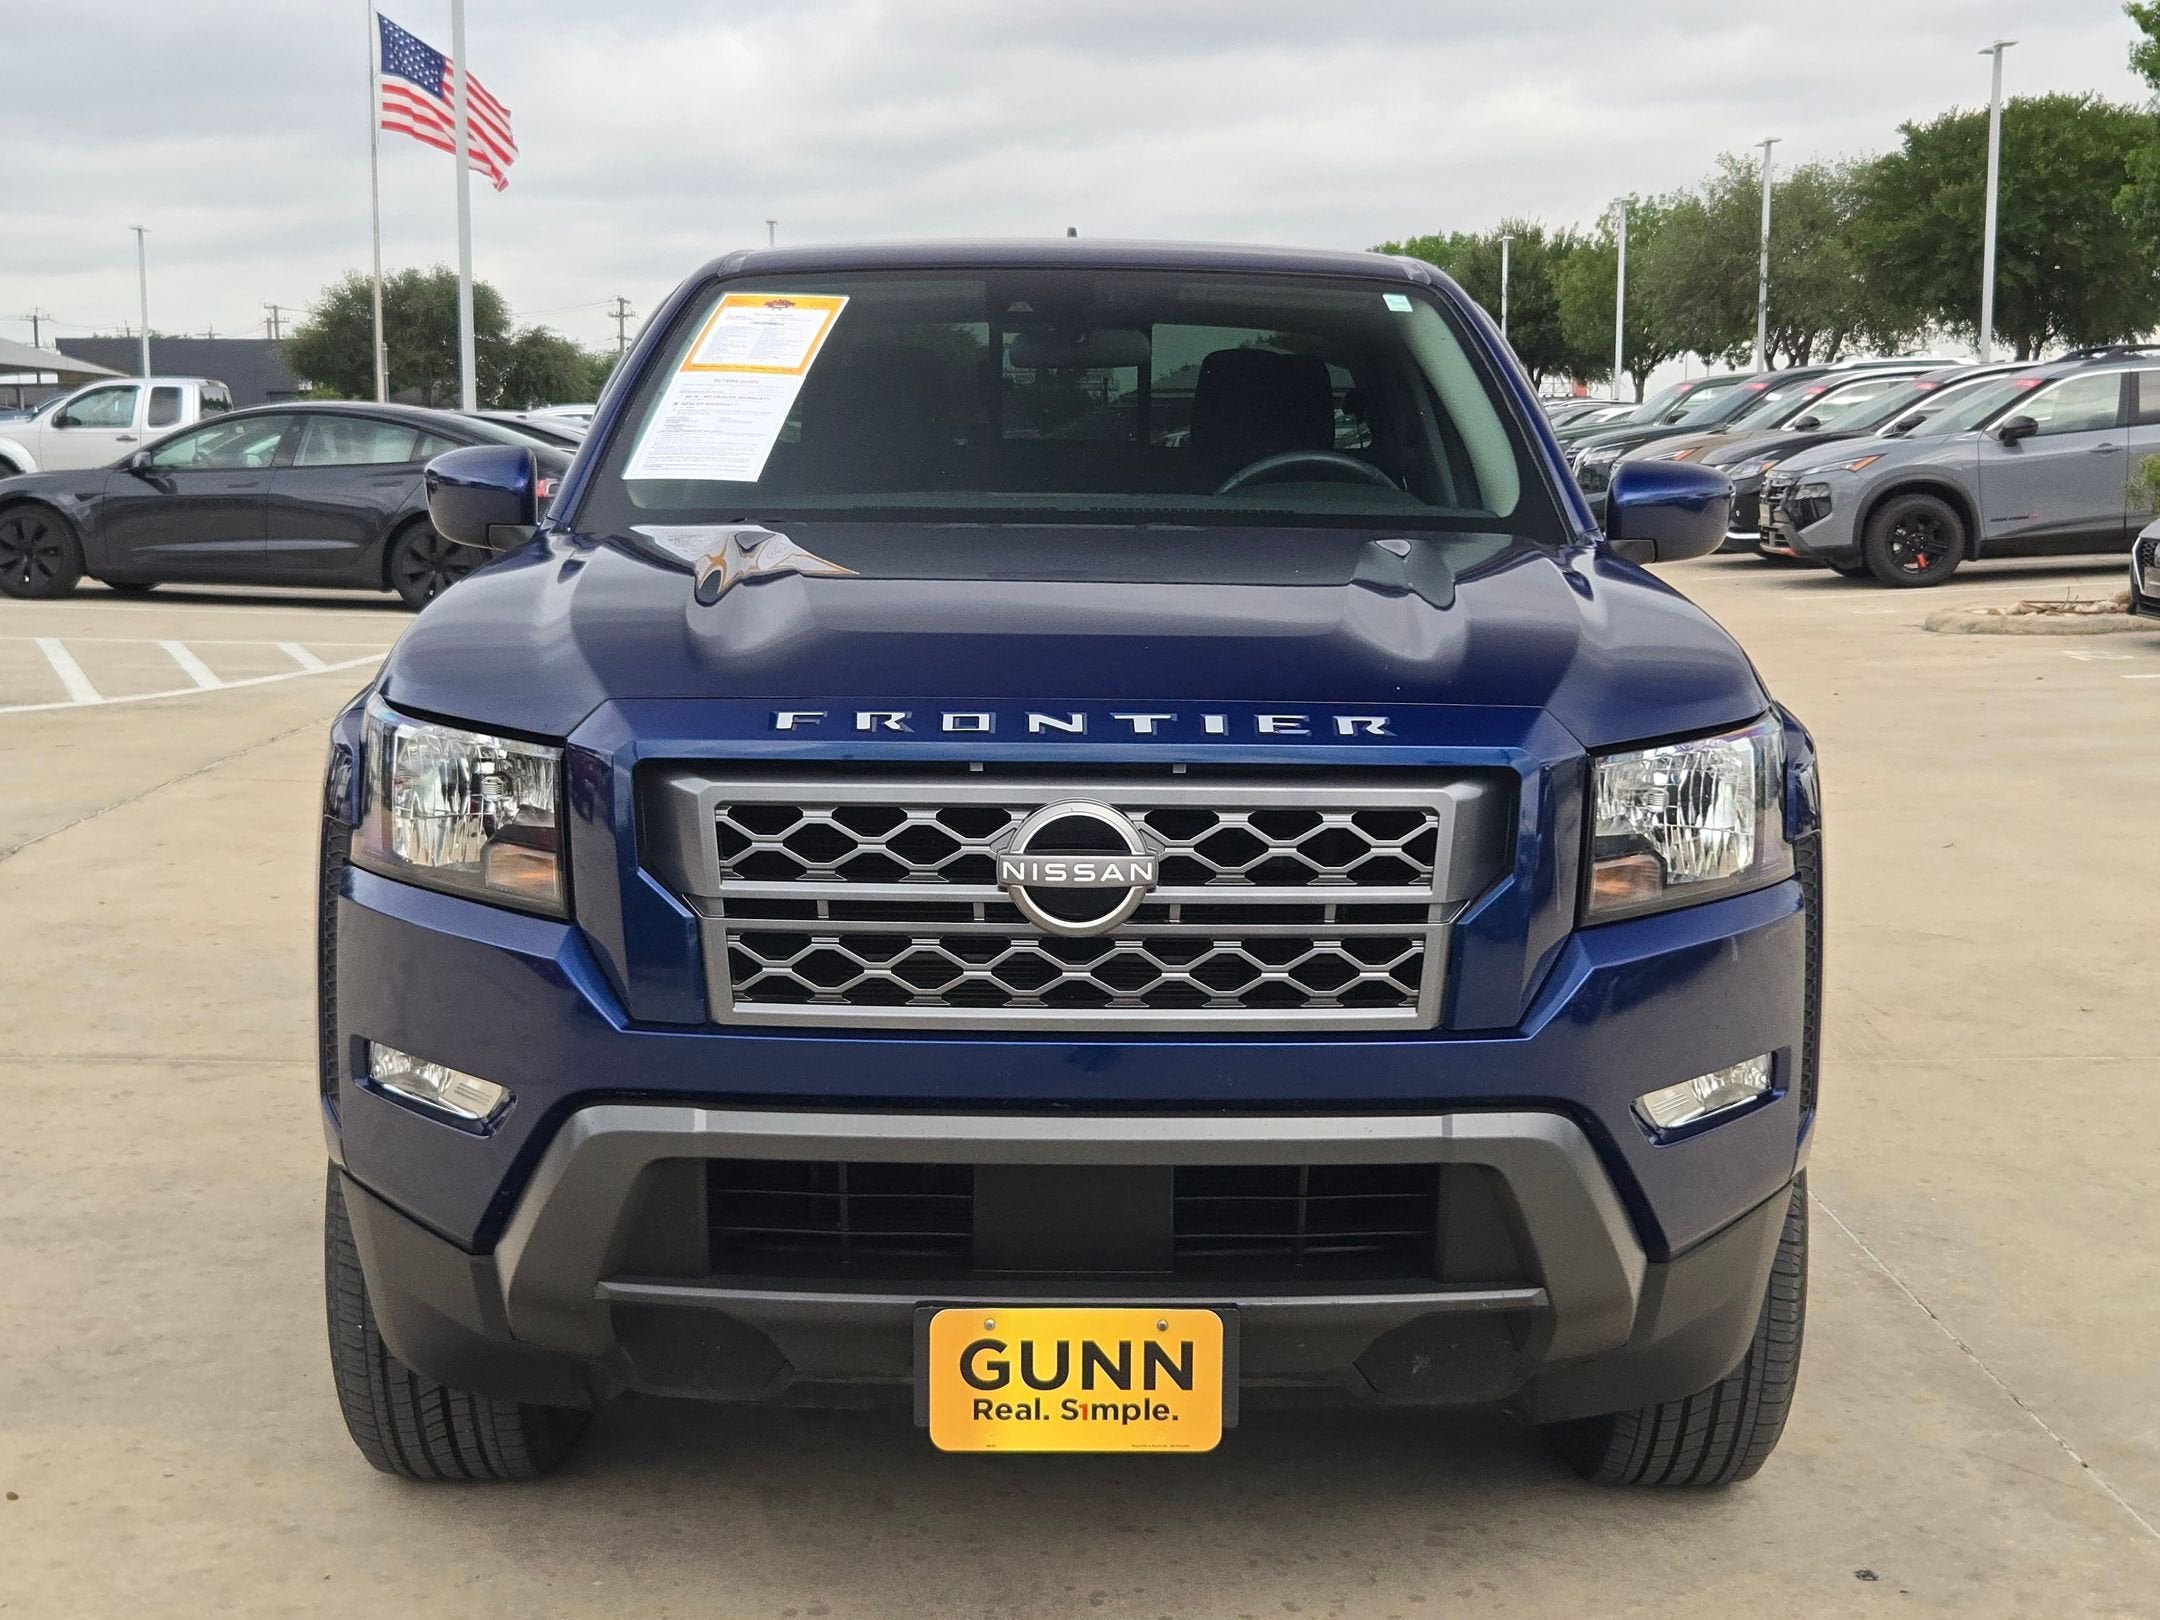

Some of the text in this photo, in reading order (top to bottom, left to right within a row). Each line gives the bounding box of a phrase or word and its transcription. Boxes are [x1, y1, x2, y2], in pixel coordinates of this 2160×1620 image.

[772, 709, 1397, 737] FRONTIER
[1002, 861, 1152, 882] NISSAN
[959, 1338, 1194, 1391] GUNN
[973, 1397, 1050, 1421] Real.
